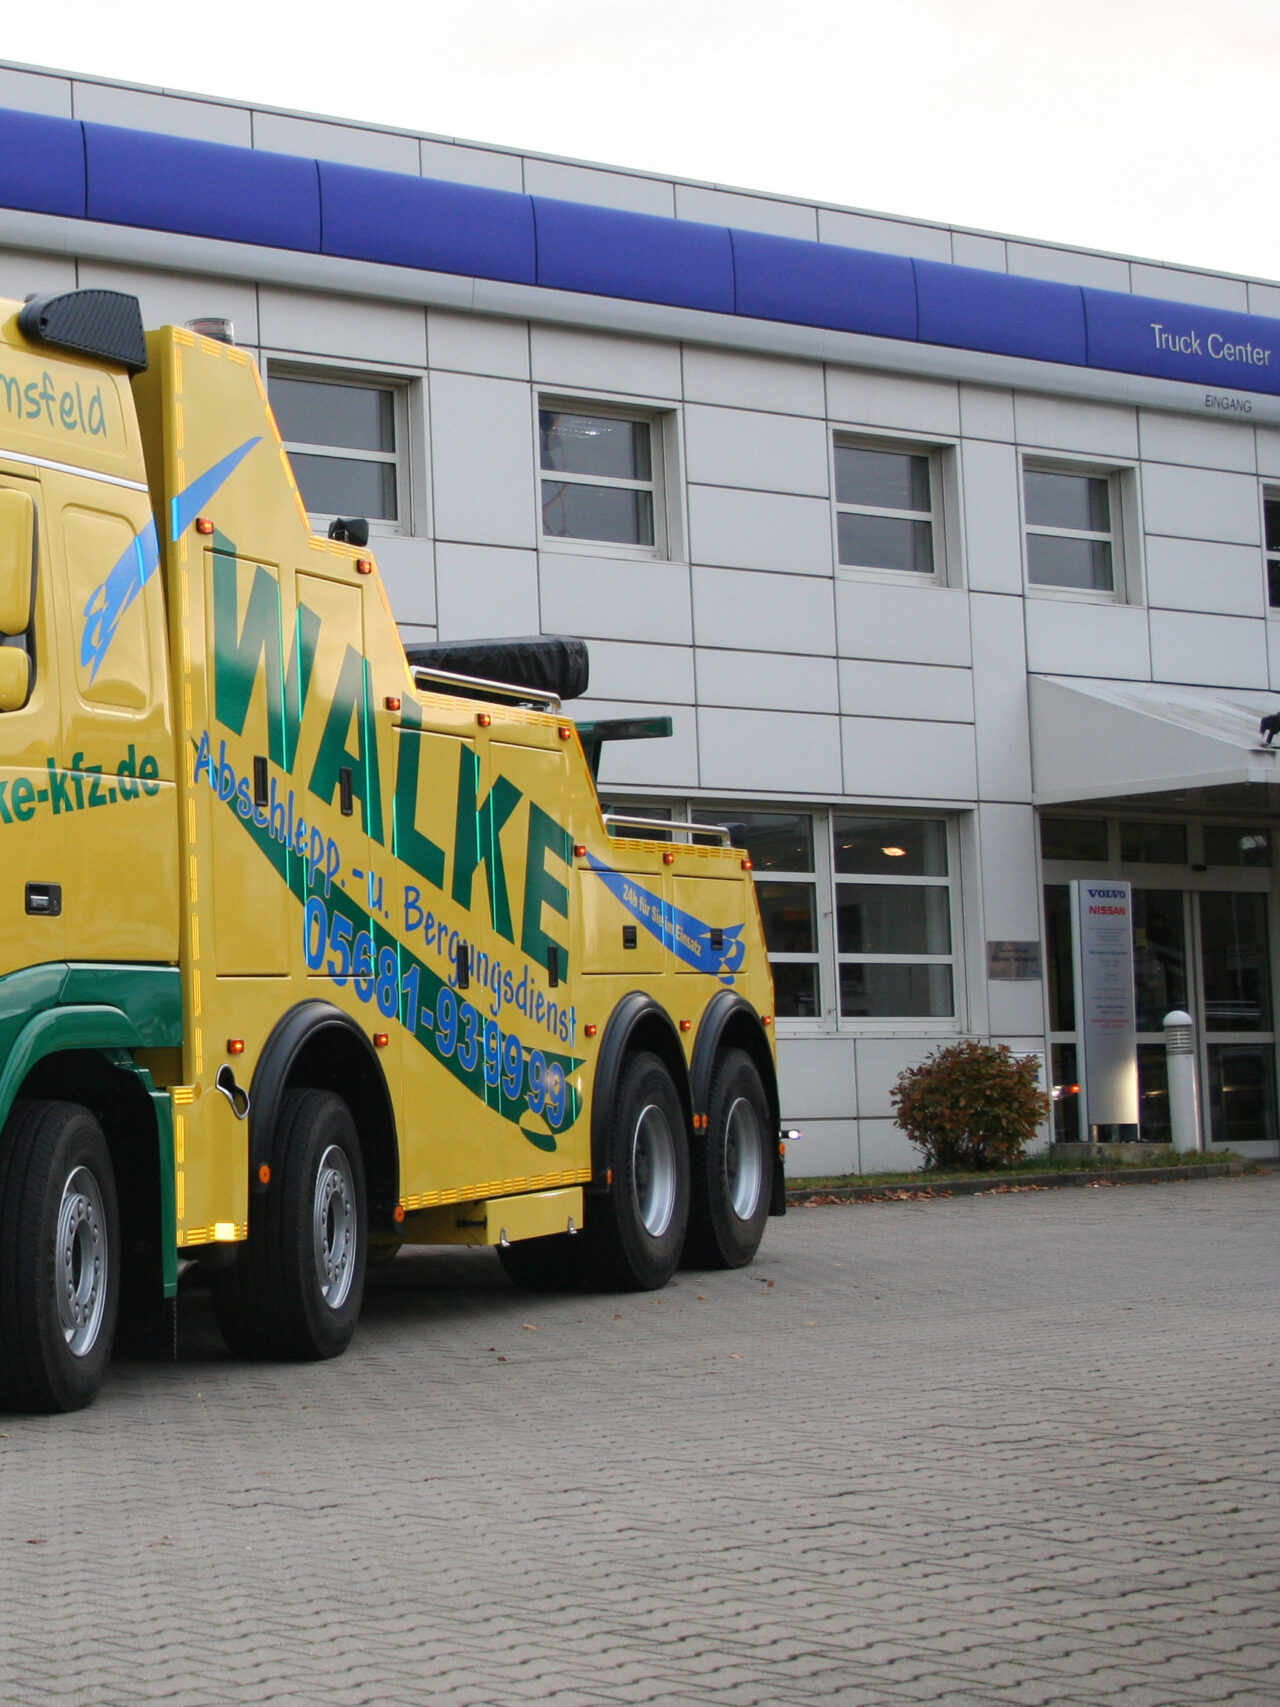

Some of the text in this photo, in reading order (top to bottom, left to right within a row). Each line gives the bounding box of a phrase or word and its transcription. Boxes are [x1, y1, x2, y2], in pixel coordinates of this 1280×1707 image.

[1150, 323, 1271, 366] Truck Center
[1204, 394, 1252, 413] EINGANG
[212, 527, 574, 985] WALKE
[1087, 889, 1126, 899] VOLVO
[622, 883, 638, 908] 24h
[639, 896, 651, 917] für
[651, 905, 664, 928] Sie
[676, 924, 702, 957] Einsatz
[1088, 905, 1126, 916] NISSAN
